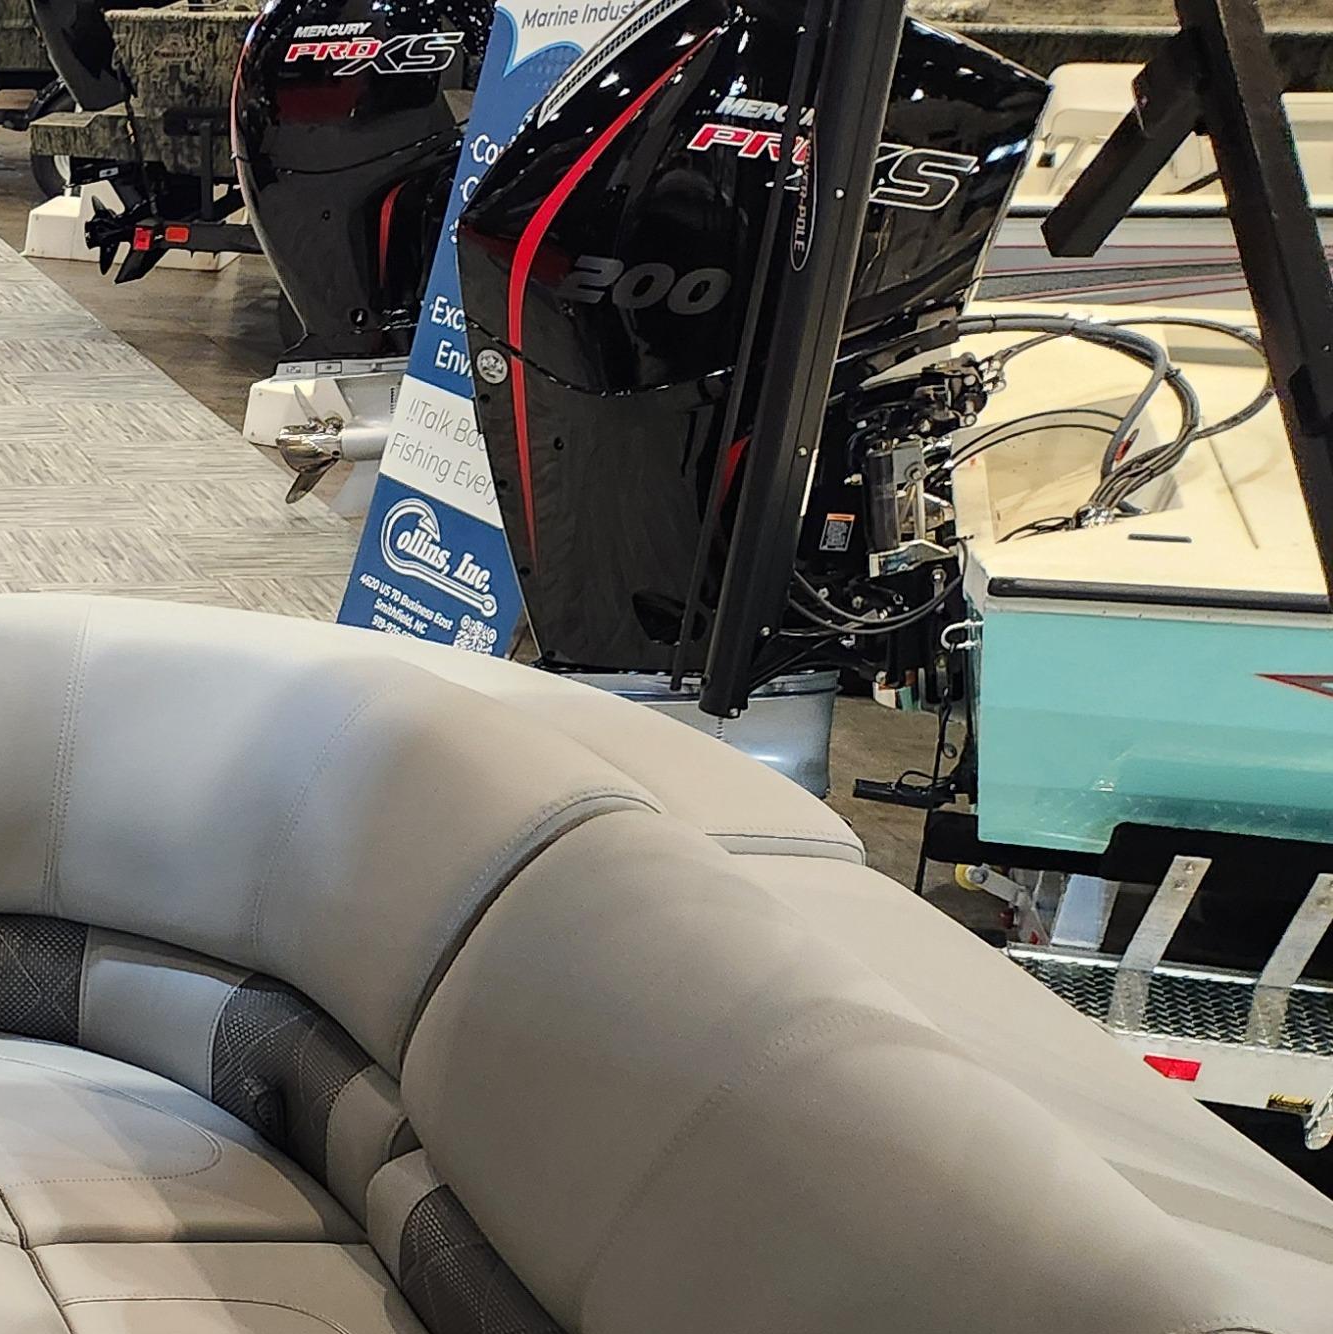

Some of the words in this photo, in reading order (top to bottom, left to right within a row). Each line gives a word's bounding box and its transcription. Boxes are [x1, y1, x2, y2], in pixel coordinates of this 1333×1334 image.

[294, 22, 372, 38] MERCURY
[521, 5, 578, 29] Marine
[582, 1, 636, 23] Indus
[285, 37, 383, 62] PRO
[333, 32, 465, 76] XS
[554, 255, 732, 316] 200
[430, 296, 467, 332] Exc
[435, 339, 473, 377] Env
[389, 432, 451, 483] Fishing
[373, 598, 414, 630] Smithfield,
[413, 619, 429, 635] NC
[379, 582, 393, 598] US
[390, 588, 403, 602] 70
[400, 594, 435, 621] Business
[433, 611, 454, 631] East
